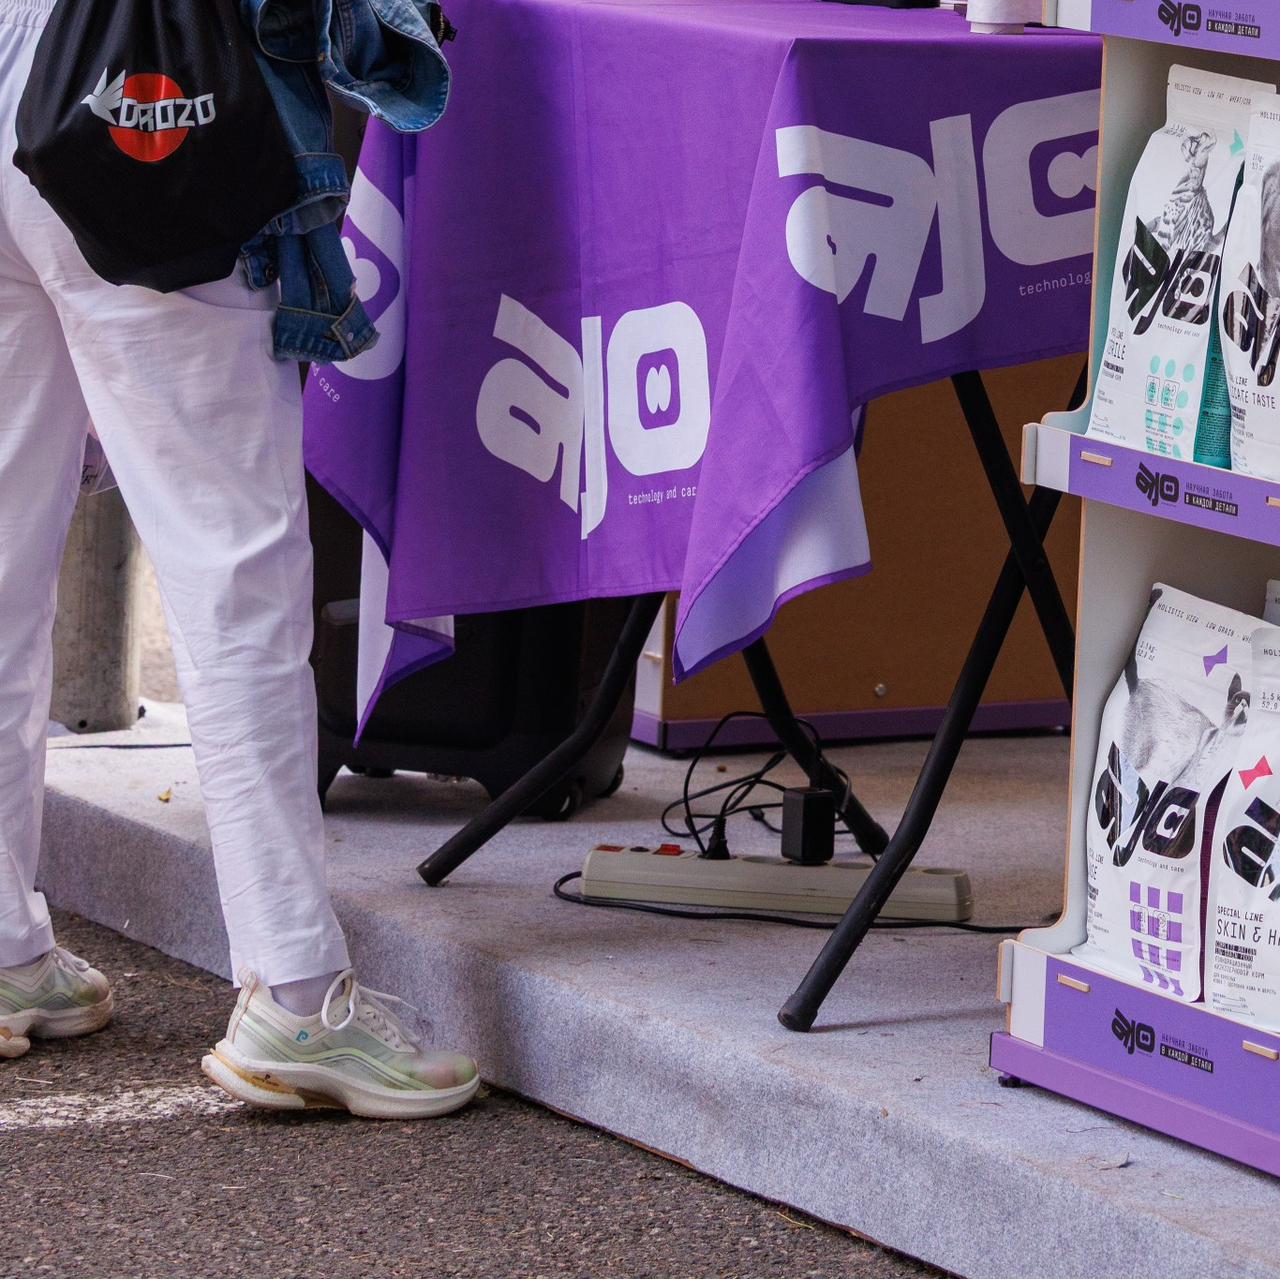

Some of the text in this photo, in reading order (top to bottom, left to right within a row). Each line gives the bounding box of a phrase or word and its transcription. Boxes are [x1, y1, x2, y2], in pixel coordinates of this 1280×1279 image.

[1019, 271, 1092, 297] technolog
[318, 377, 341, 402] care
[1252, 392, 1276, 409] TASTE
[628, 485, 697, 505] technology and car
[1212, 487, 1233, 500] ЗАБОТА
[1215, 501, 1237, 514] ДЕТАЛИ
[1157, 602, 1235, 638] HOLISTIC VIEW LOW GRAIN
[1262, 691, 1274, 701] 1.5
[1261, 701, 1278, 711] 52.9
[1217, 905, 1264, 923] SPECIAL LINE
[1216, 918, 1246, 941] SKIN
[1252, 926, 1262, 943] &
[1190, 1056, 1212, 1071] ДЕТАЛИ
